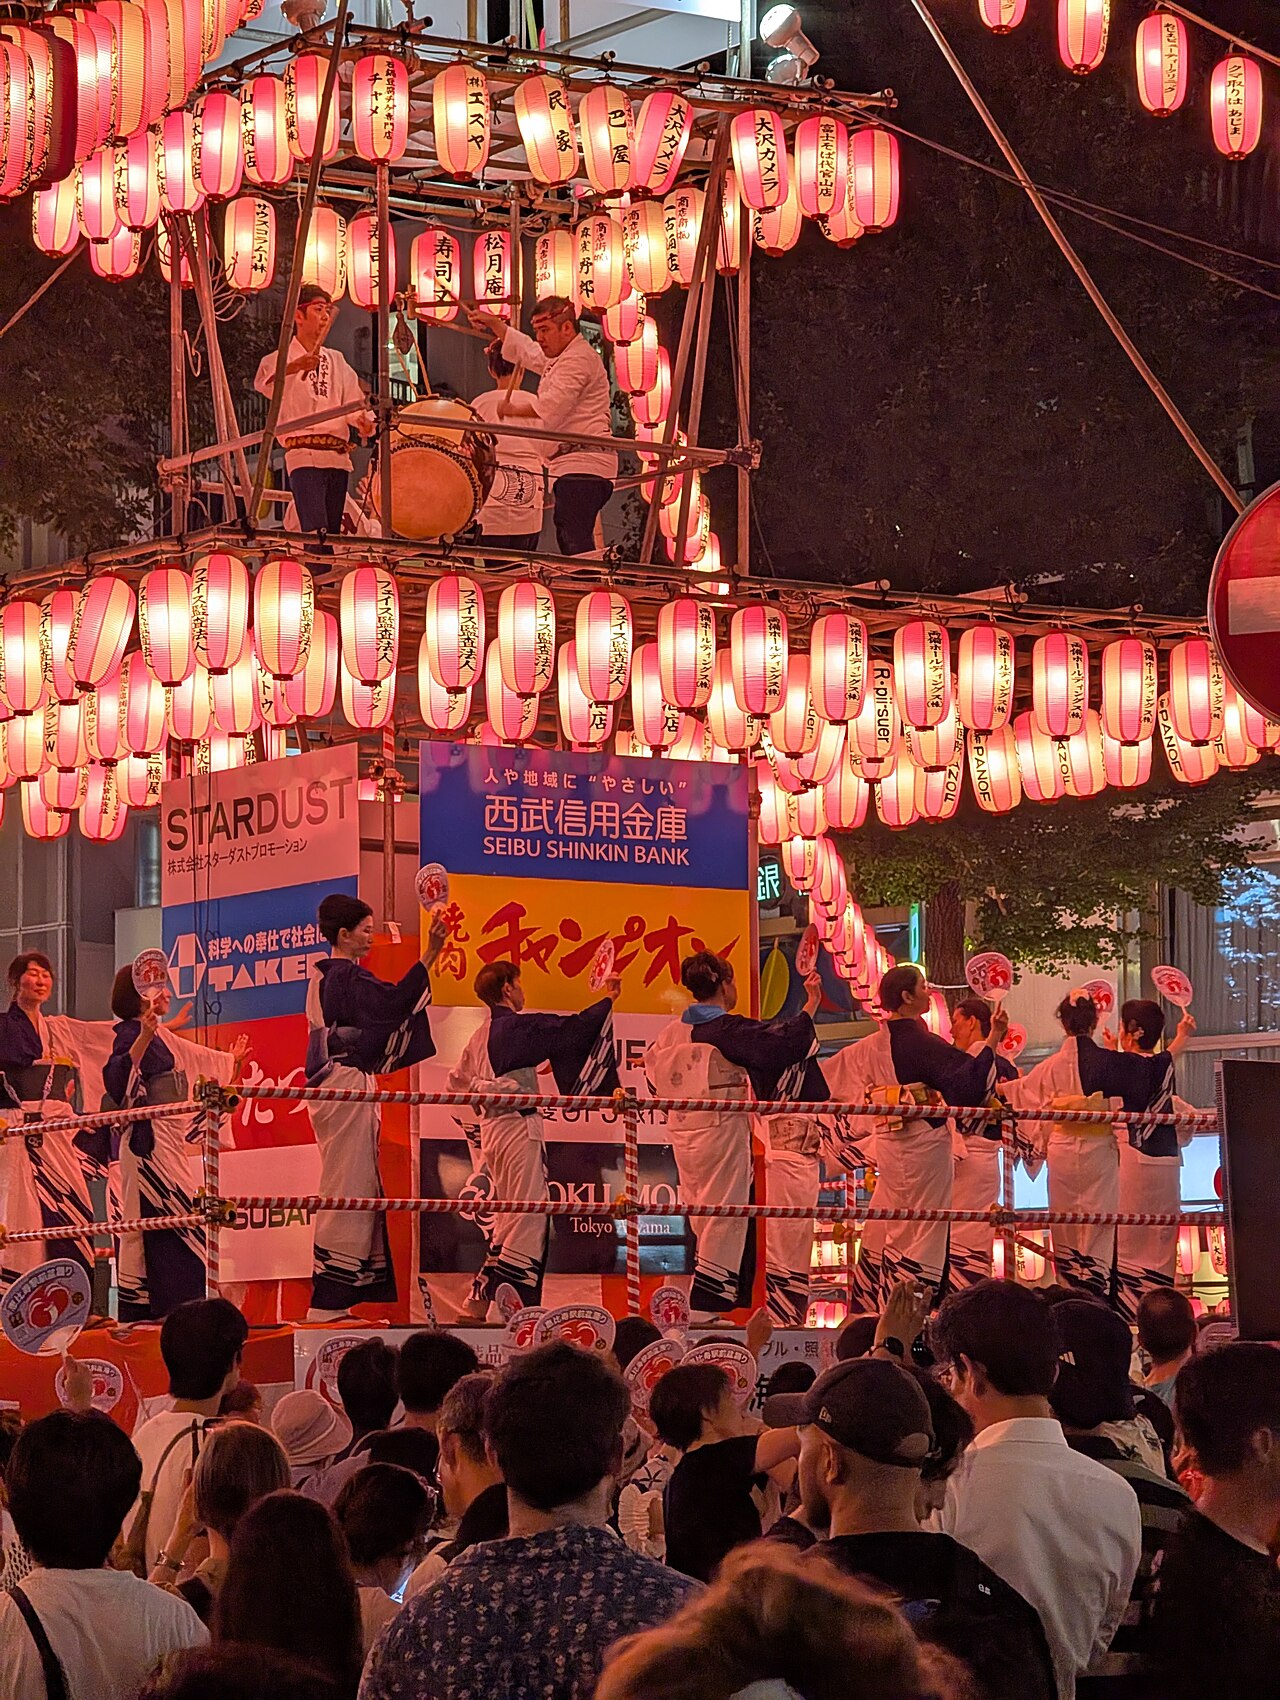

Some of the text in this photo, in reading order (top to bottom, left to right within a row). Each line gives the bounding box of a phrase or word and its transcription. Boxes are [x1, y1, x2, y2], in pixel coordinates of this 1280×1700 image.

[241, 88, 256, 169] 山本商店
[548, 89, 573, 151] 民家
[608, 109, 630, 165] 巴屋
[653, 104, 686, 175] 大沢カメラ
[114, 151, 129, 209] びす太鼓
[754, 117, 780, 192] 大沢カメラ
[818, 123, 836, 197] 富士そば代官山店
[484, 233, 505, 297] 松月庵
[376, 580, 394, 664] フェイス監査法人
[459, 589, 478, 672] フェイス監査法人
[534, 597, 552, 680] フェイス監査法人
[609, 606, 629, 686] フェイス監査法人
[147, 752, 163, 795] 三橋屋
[166, 776, 353, 852] STARDUST
[484, 793, 688, 844] 西武信用金庫
[167, 837, 308, 876] 株式会社スターダストプロモーション
[483, 836, 690, 867] SEIBU SHINKIN BANK
[570, 1216, 613, 1238] Tokyo
